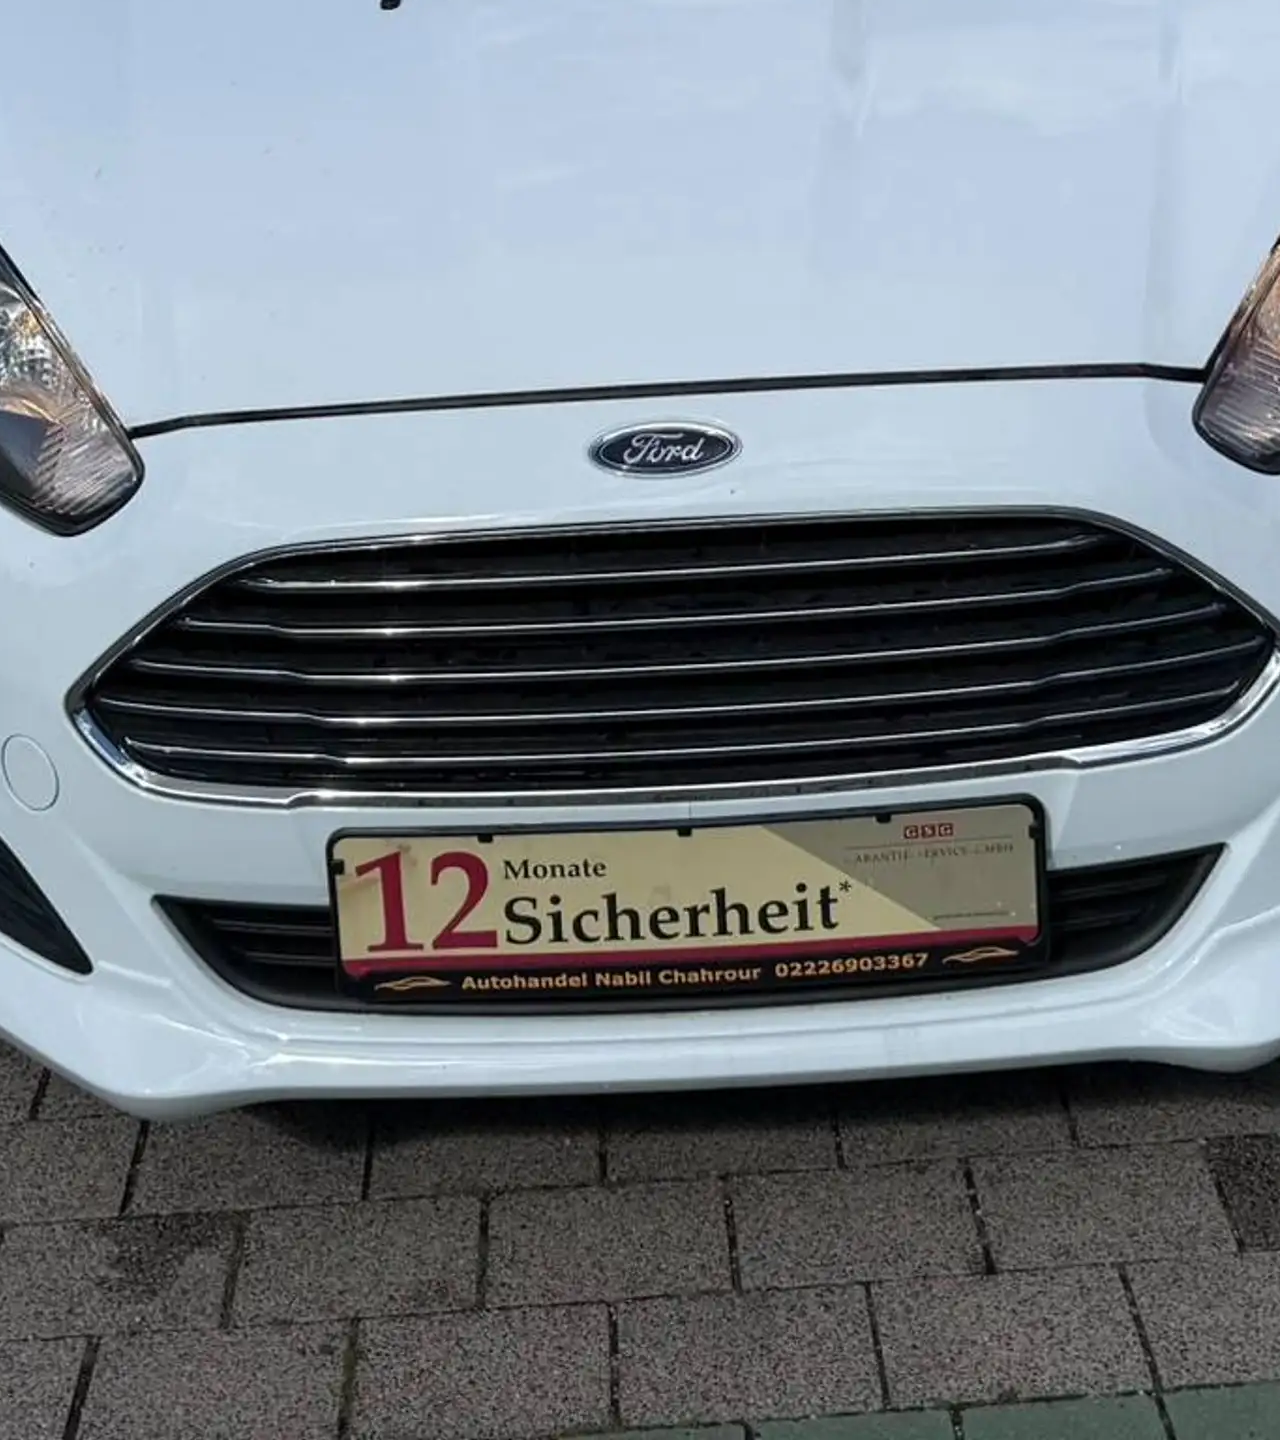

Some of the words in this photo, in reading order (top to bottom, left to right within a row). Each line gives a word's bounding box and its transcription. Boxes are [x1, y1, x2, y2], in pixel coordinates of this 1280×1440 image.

[623, 433, 705, 464] Ford
[503, 858, 607, 879] Monate
[355, 850, 498, 953] 12
[461, 972, 587, 991] Autohandel
[595, 970, 651, 988] Nabil
[658, 964, 761, 985] Chahrour
[775, 953, 929, 978] 02226903367
